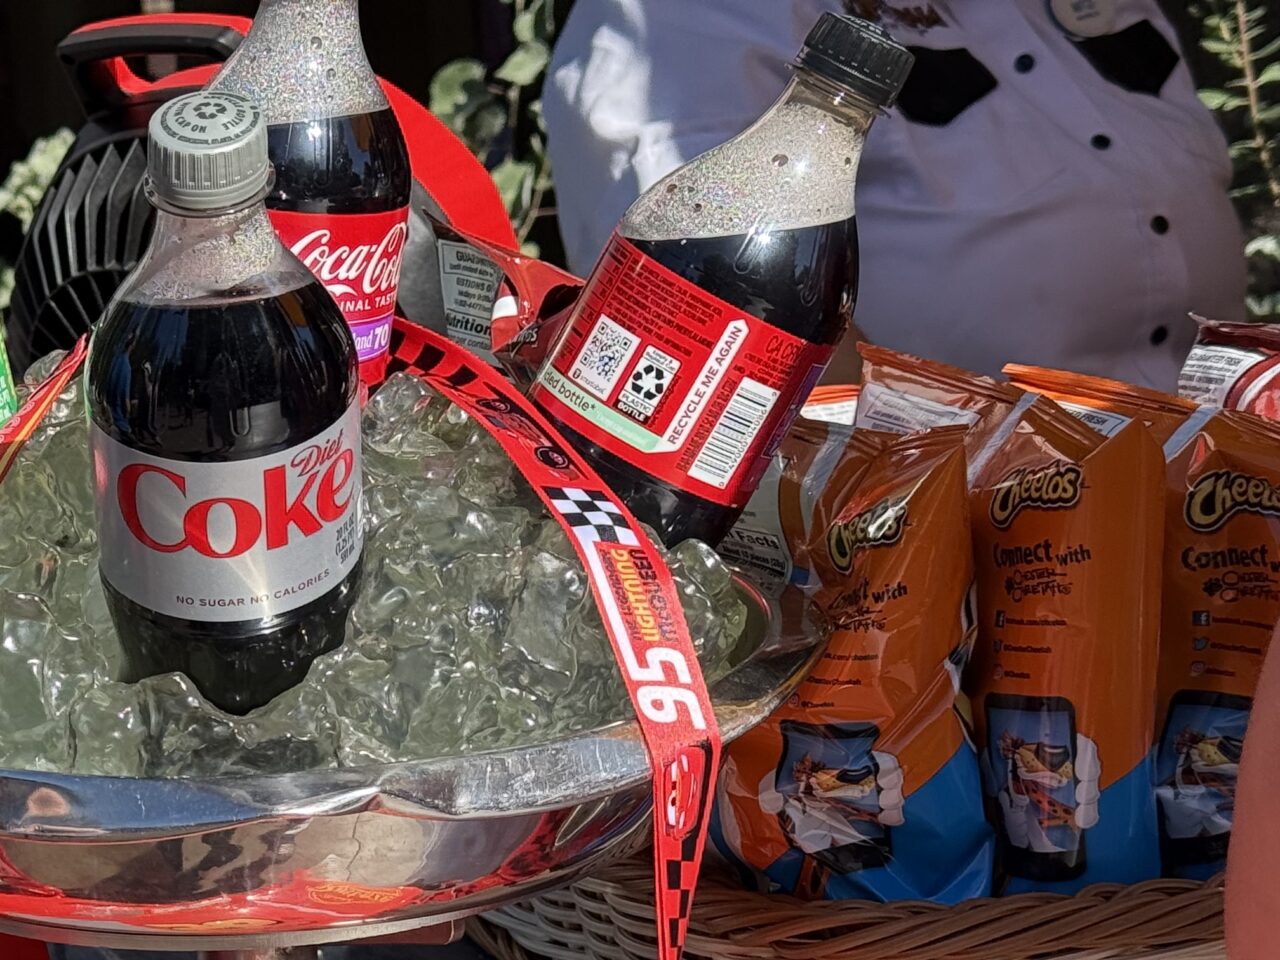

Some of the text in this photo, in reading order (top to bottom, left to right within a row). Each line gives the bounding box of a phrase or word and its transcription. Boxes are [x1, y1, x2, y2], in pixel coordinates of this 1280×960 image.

[191, 124, 208, 134] ON
[373, 323, 389, 350] 70
[667, 389, 706, 445] RECYCLE
[701, 366, 719, 389] ME
[715, 325, 743, 363] AGAIN
[617, 401, 647, 420] BOTTLE
[622, 391, 651, 414] PLASTIC
[1081, 413, 1107, 426] FRESH
[290, 428, 344, 477] Diet
[117, 448, 354, 559] Coke
[991, 459, 1083, 529] Cheetos
[735, 530, 780, 550] Facts
[993, 539, 1091, 568] Connect with
[1181, 544, 1268, 572] Connect
[176, 568, 331, 608] NO SUGAR NO CALORIES
[610, 549, 662, 642] LIGHTNING
[872, 581, 908, 603] with
[636, 647, 707, 731] 95
